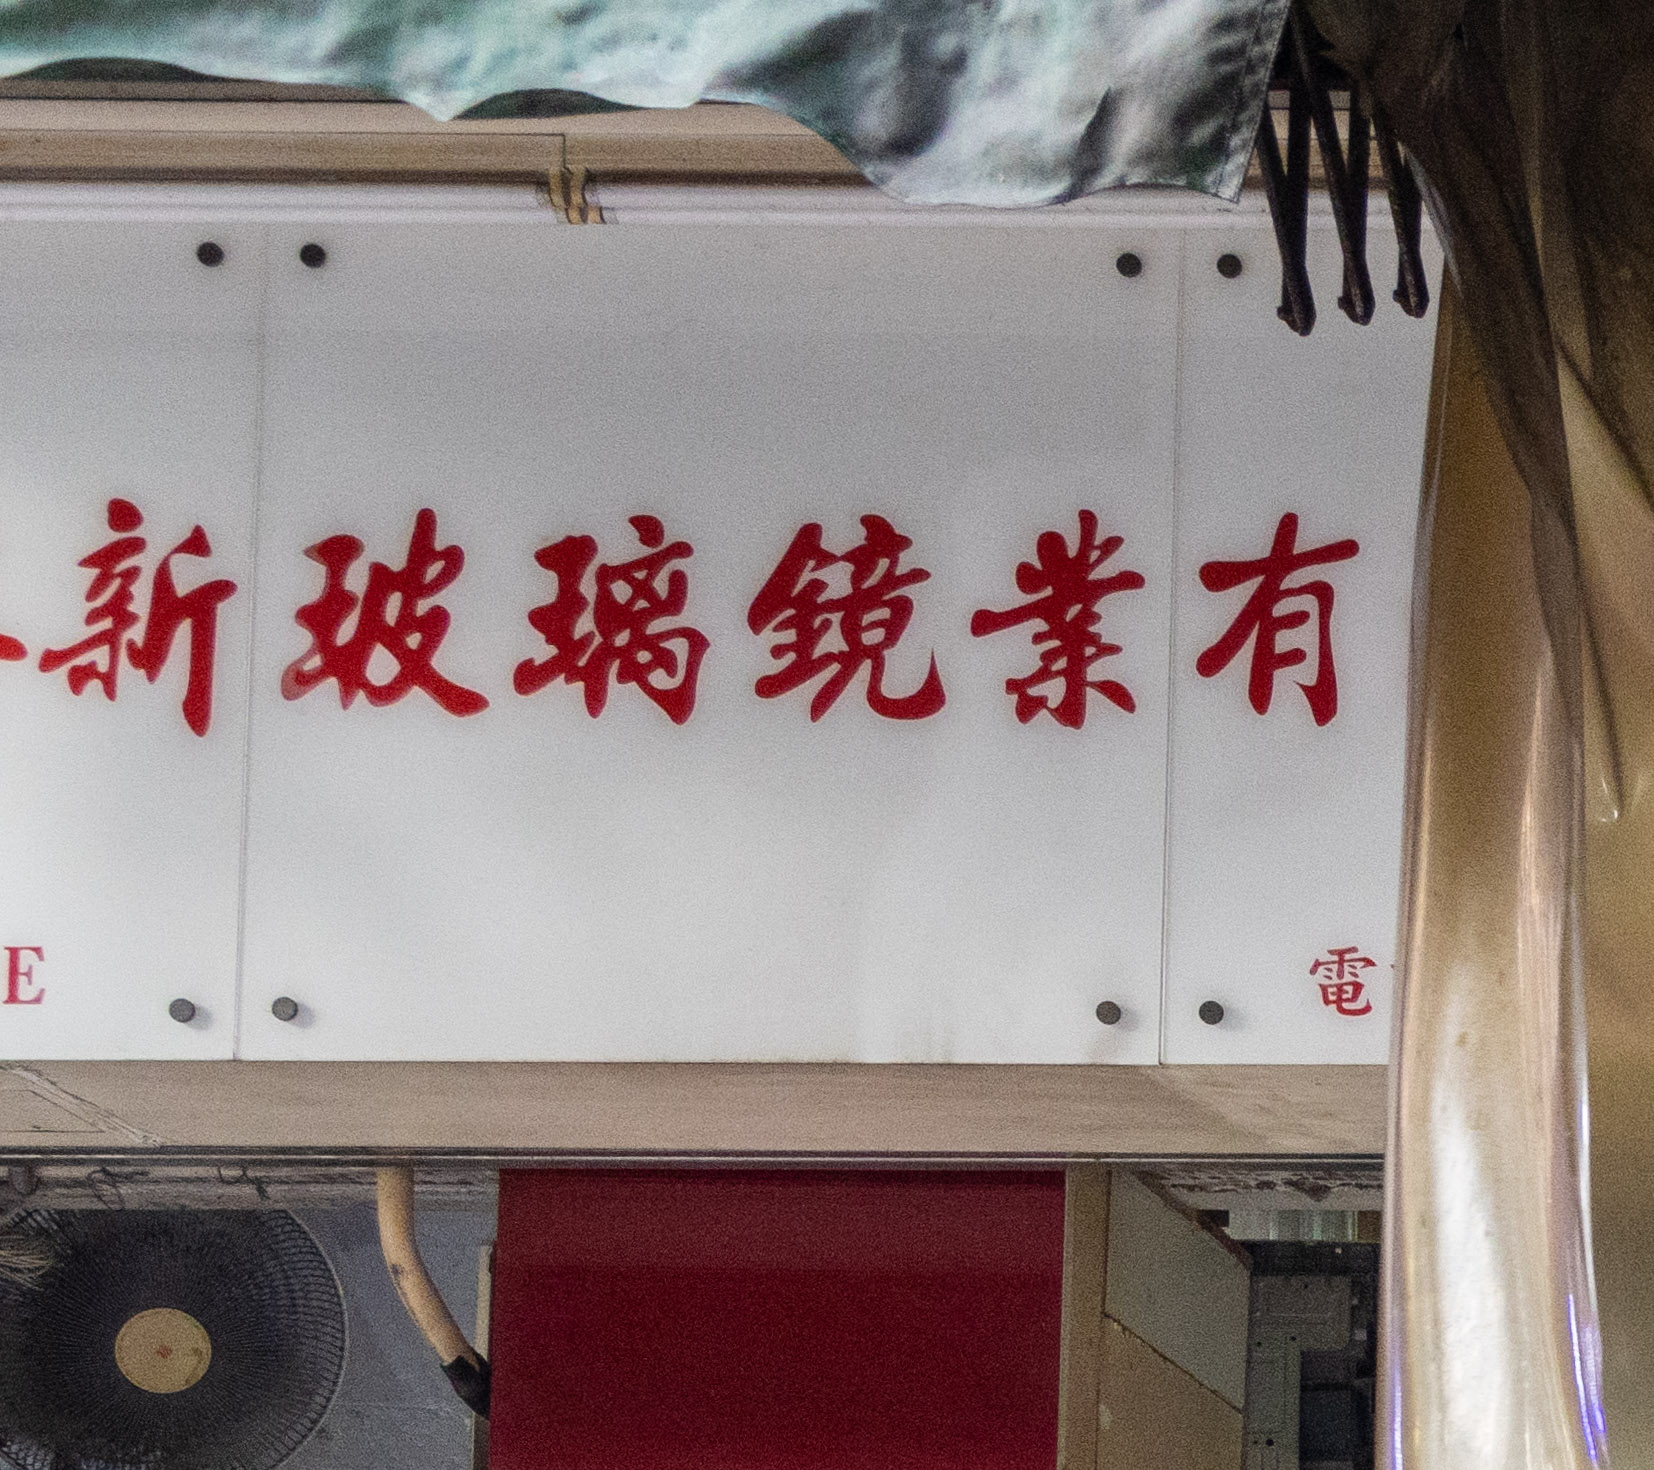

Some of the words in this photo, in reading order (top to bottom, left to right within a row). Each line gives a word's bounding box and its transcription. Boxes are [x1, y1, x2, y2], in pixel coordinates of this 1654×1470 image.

[0, 498, 1360, 737] 新玻璃鏡業有
